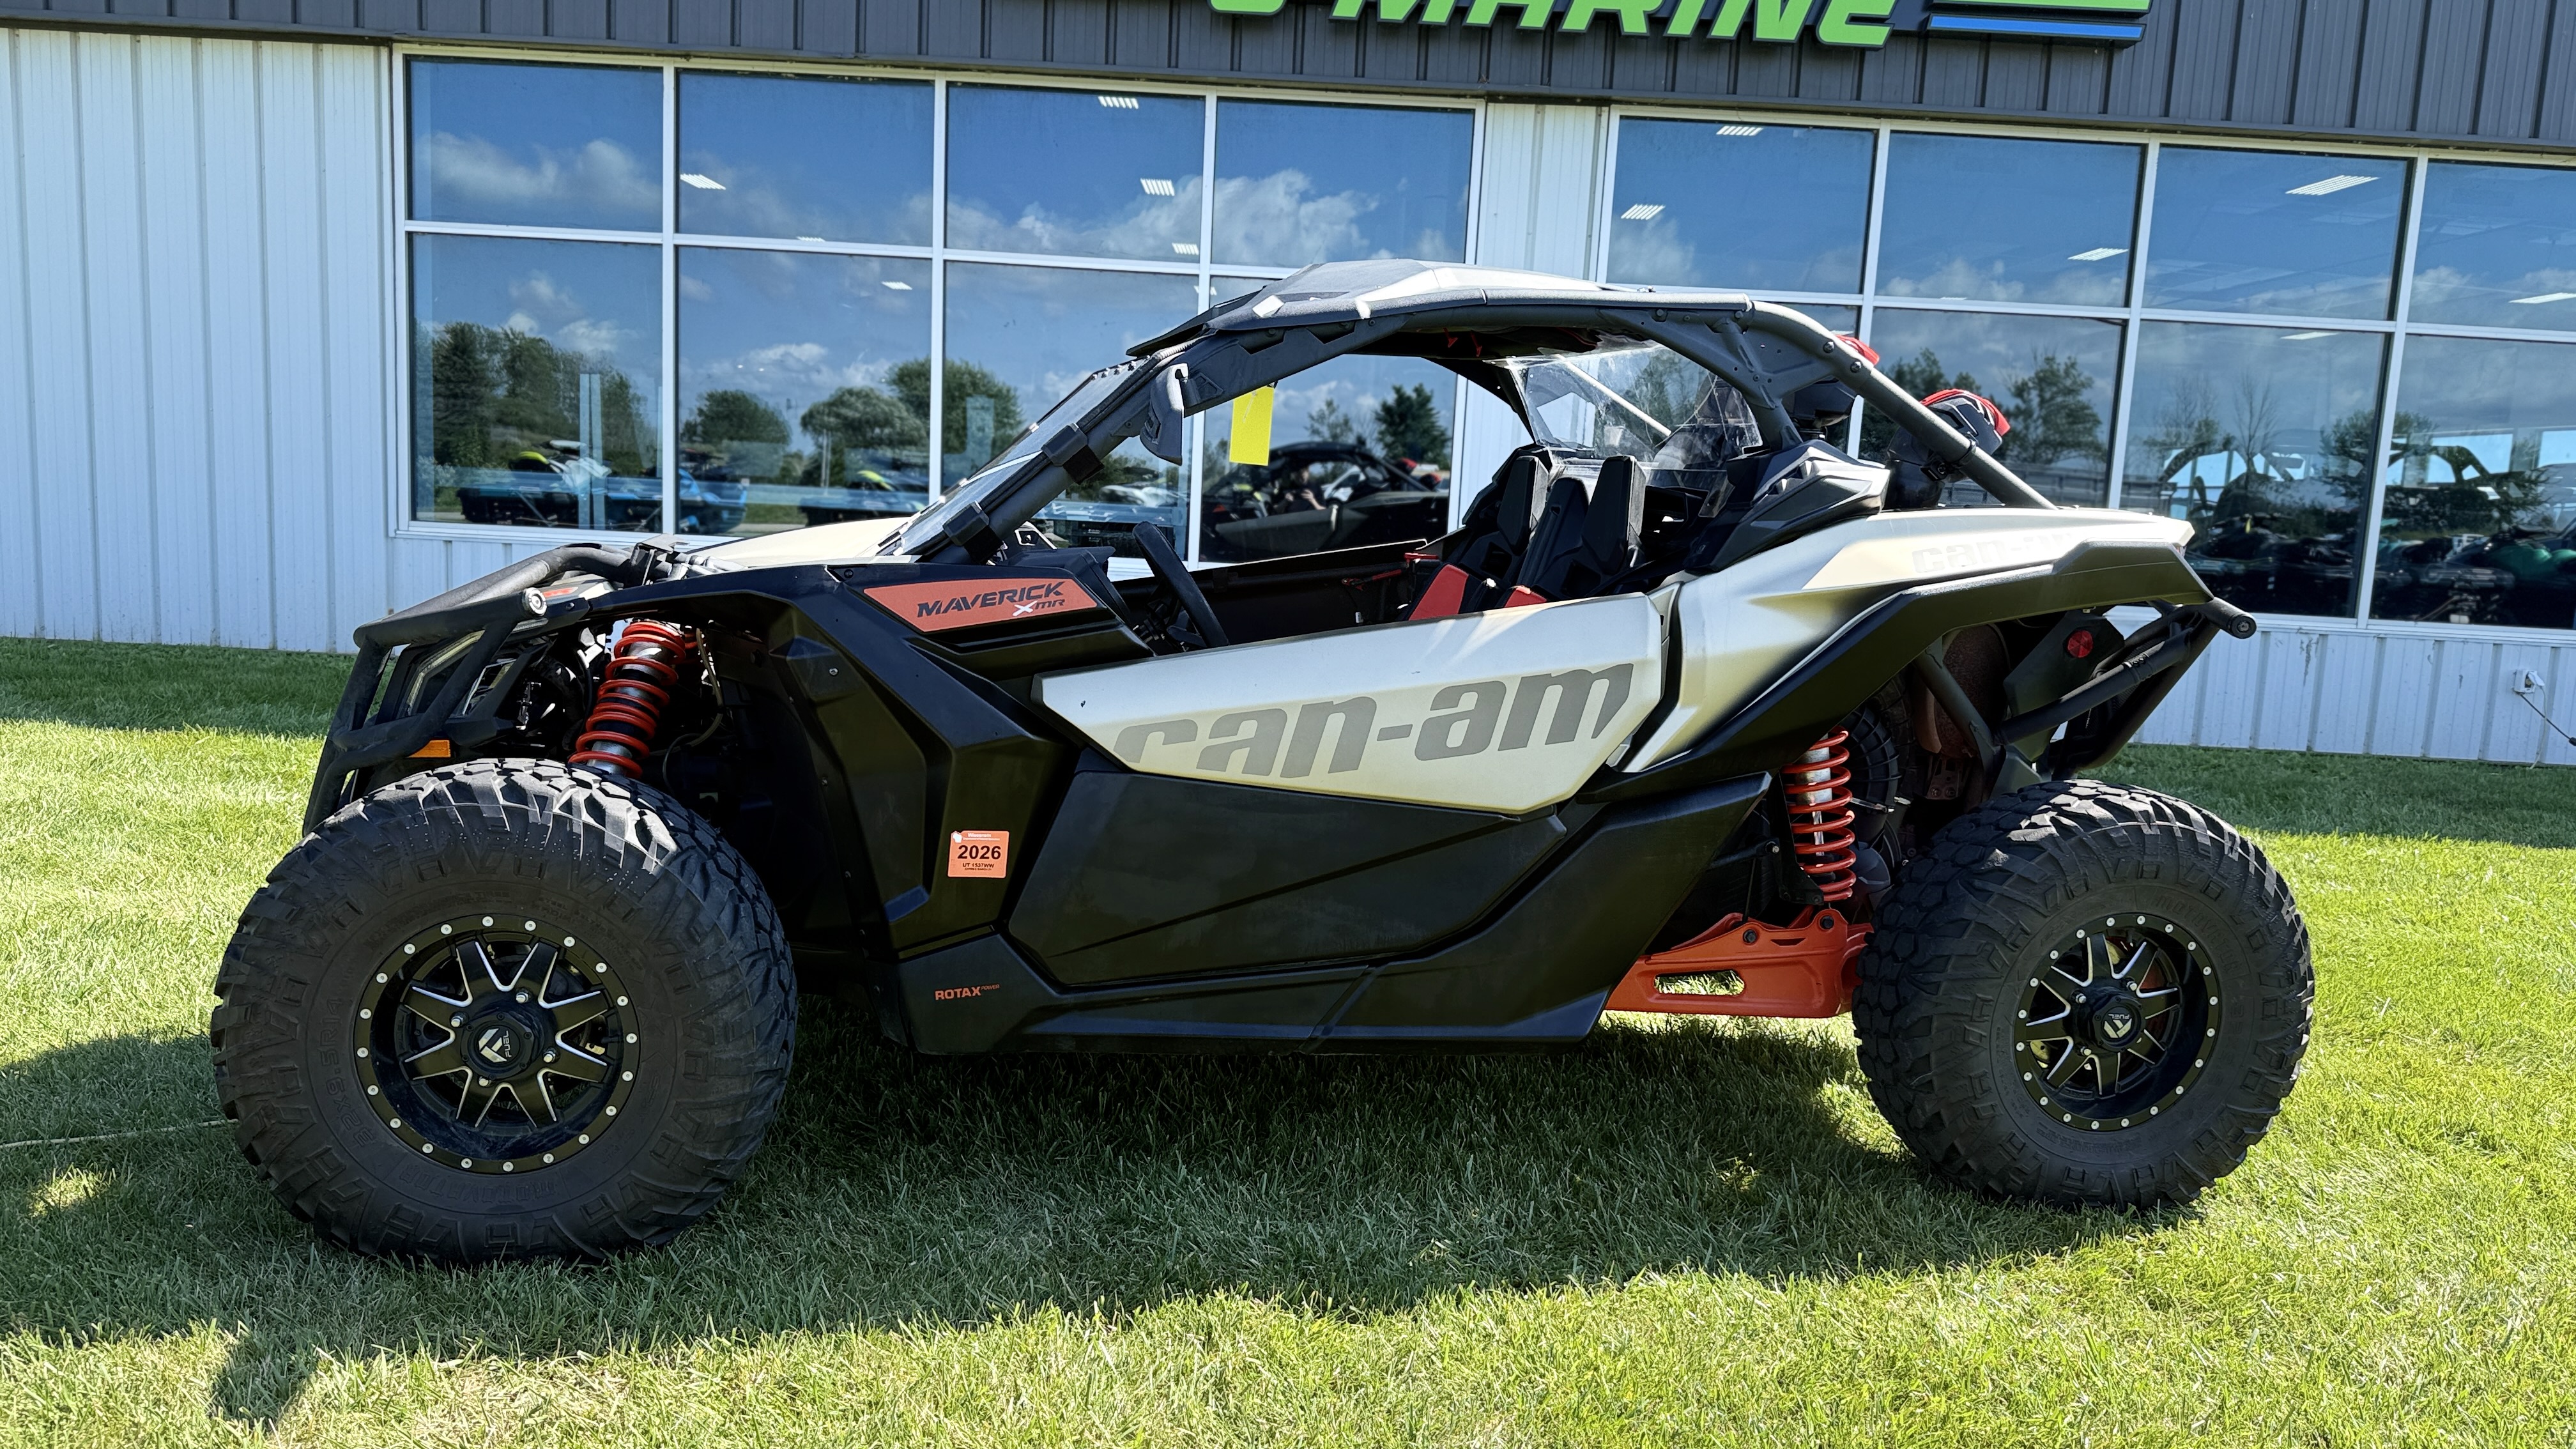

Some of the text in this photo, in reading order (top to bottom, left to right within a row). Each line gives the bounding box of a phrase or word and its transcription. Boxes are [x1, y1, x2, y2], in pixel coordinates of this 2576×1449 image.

[1328, 0, 1896, 47] RINE
[916, 581, 1065, 618] MAVERICK
[1113, 663, 1634, 778] can-am
[957, 845, 1001, 860] 2026
[935, 986, 981, 1000] ROTAX
[503, 1030, 512, 1058] FUEL
